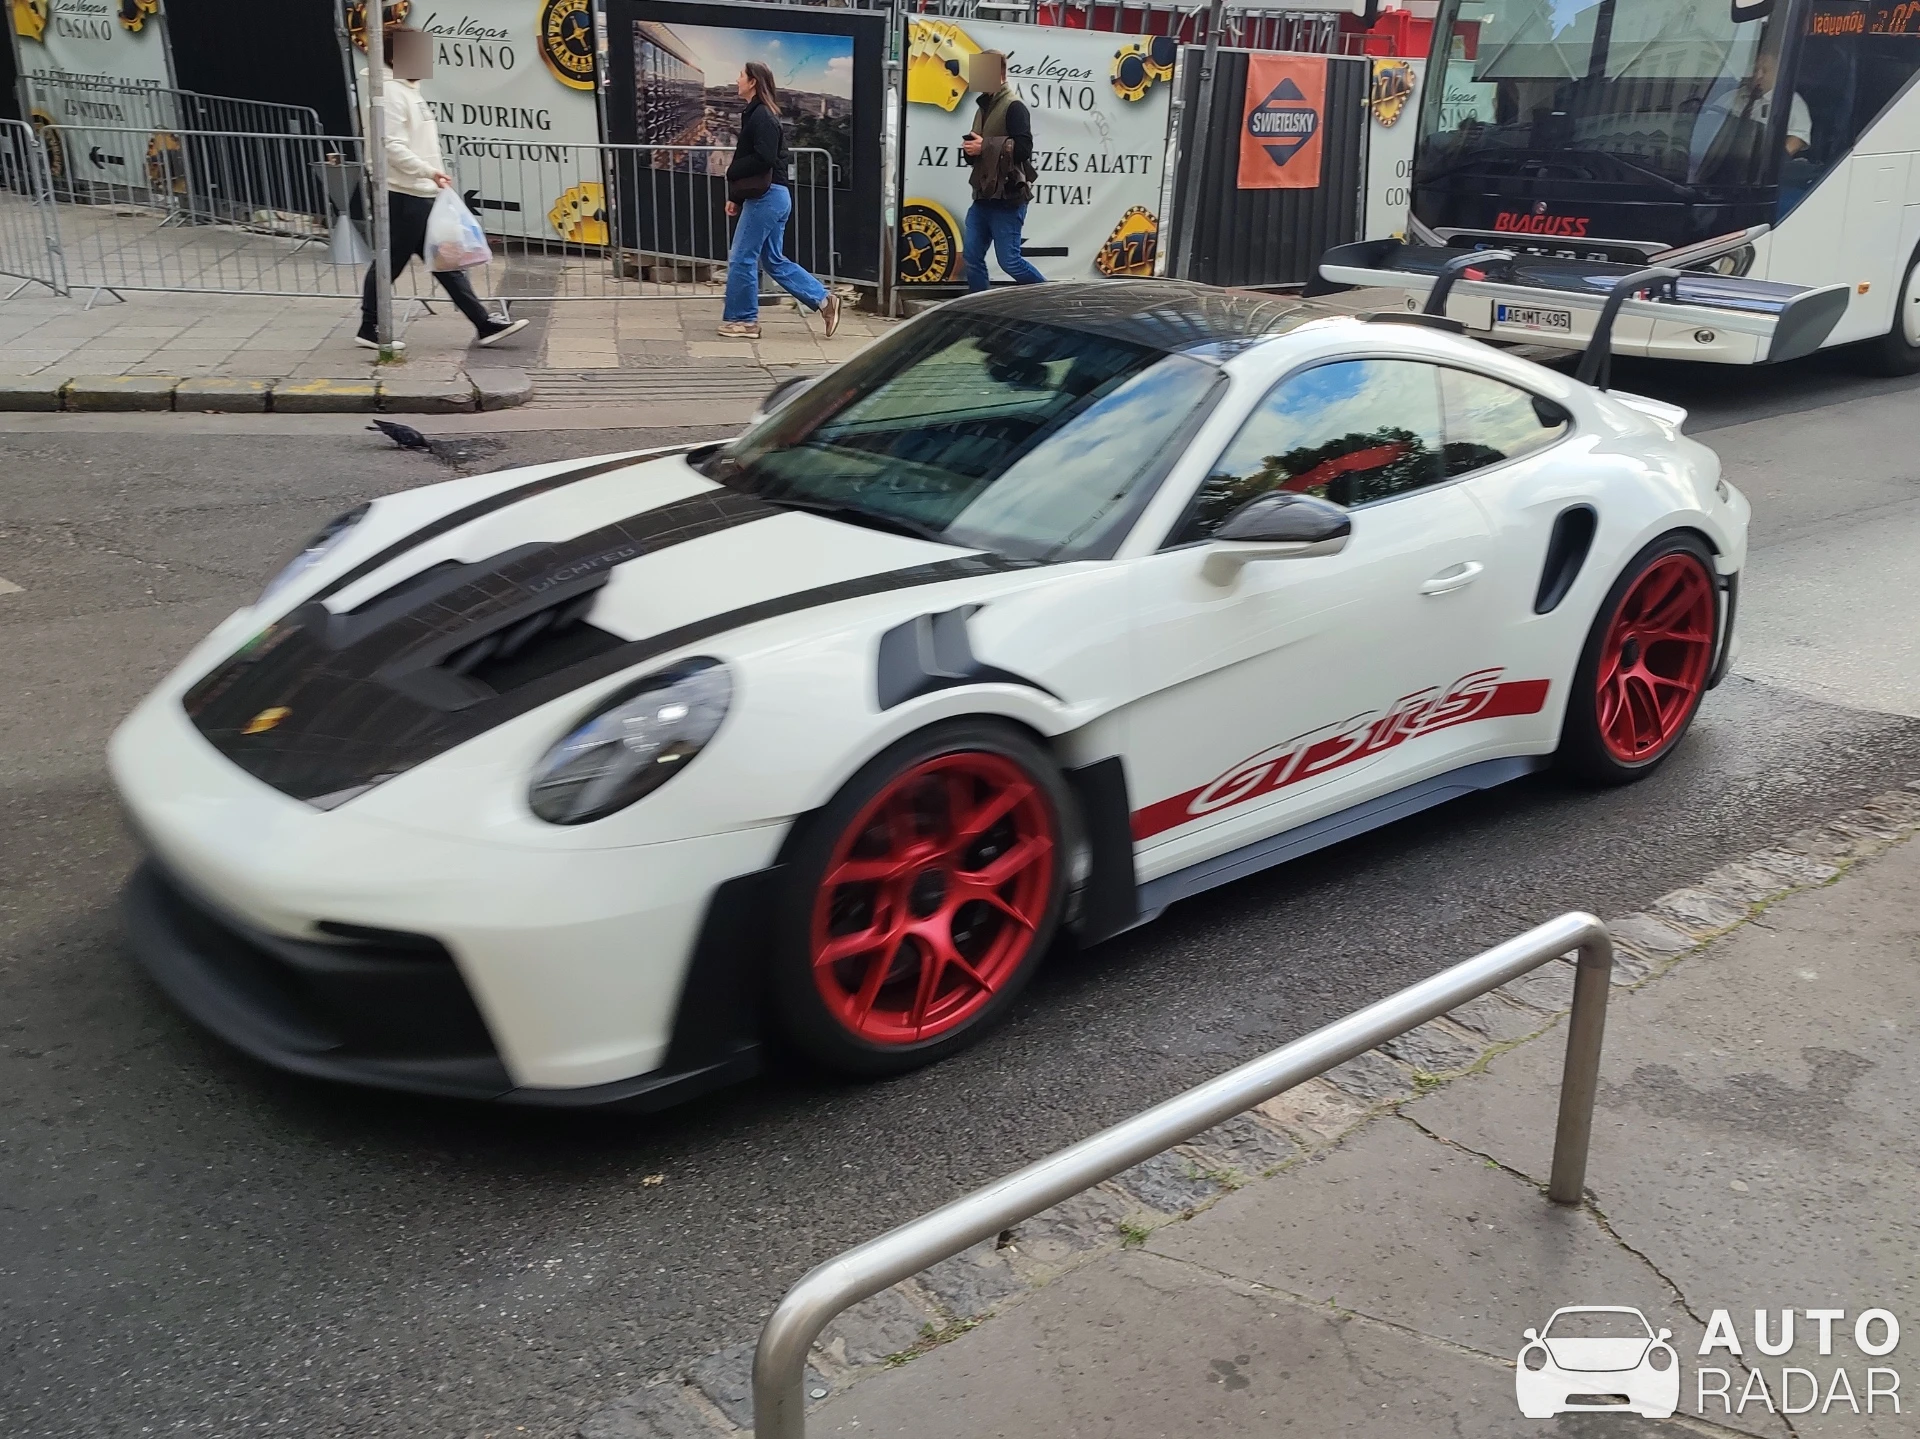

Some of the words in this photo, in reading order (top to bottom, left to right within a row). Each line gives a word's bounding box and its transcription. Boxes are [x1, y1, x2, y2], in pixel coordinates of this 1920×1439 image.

[56, 17, 112, 41] CASINO
[457, 16, 508, 43] Vegas
[433, 43, 515, 70] ASINO
[1037, 55, 1094, 83] Vegas
[461, 103, 551, 131] DURING
[1252, 112, 1315, 133] SWIETELSKY
[438, 133, 569, 164] TRUCTION!
[917, 146, 949, 168] AZ
[1084, 153, 1153, 174] ALATT
[1494, 211, 1590, 238] BLAGUSS
